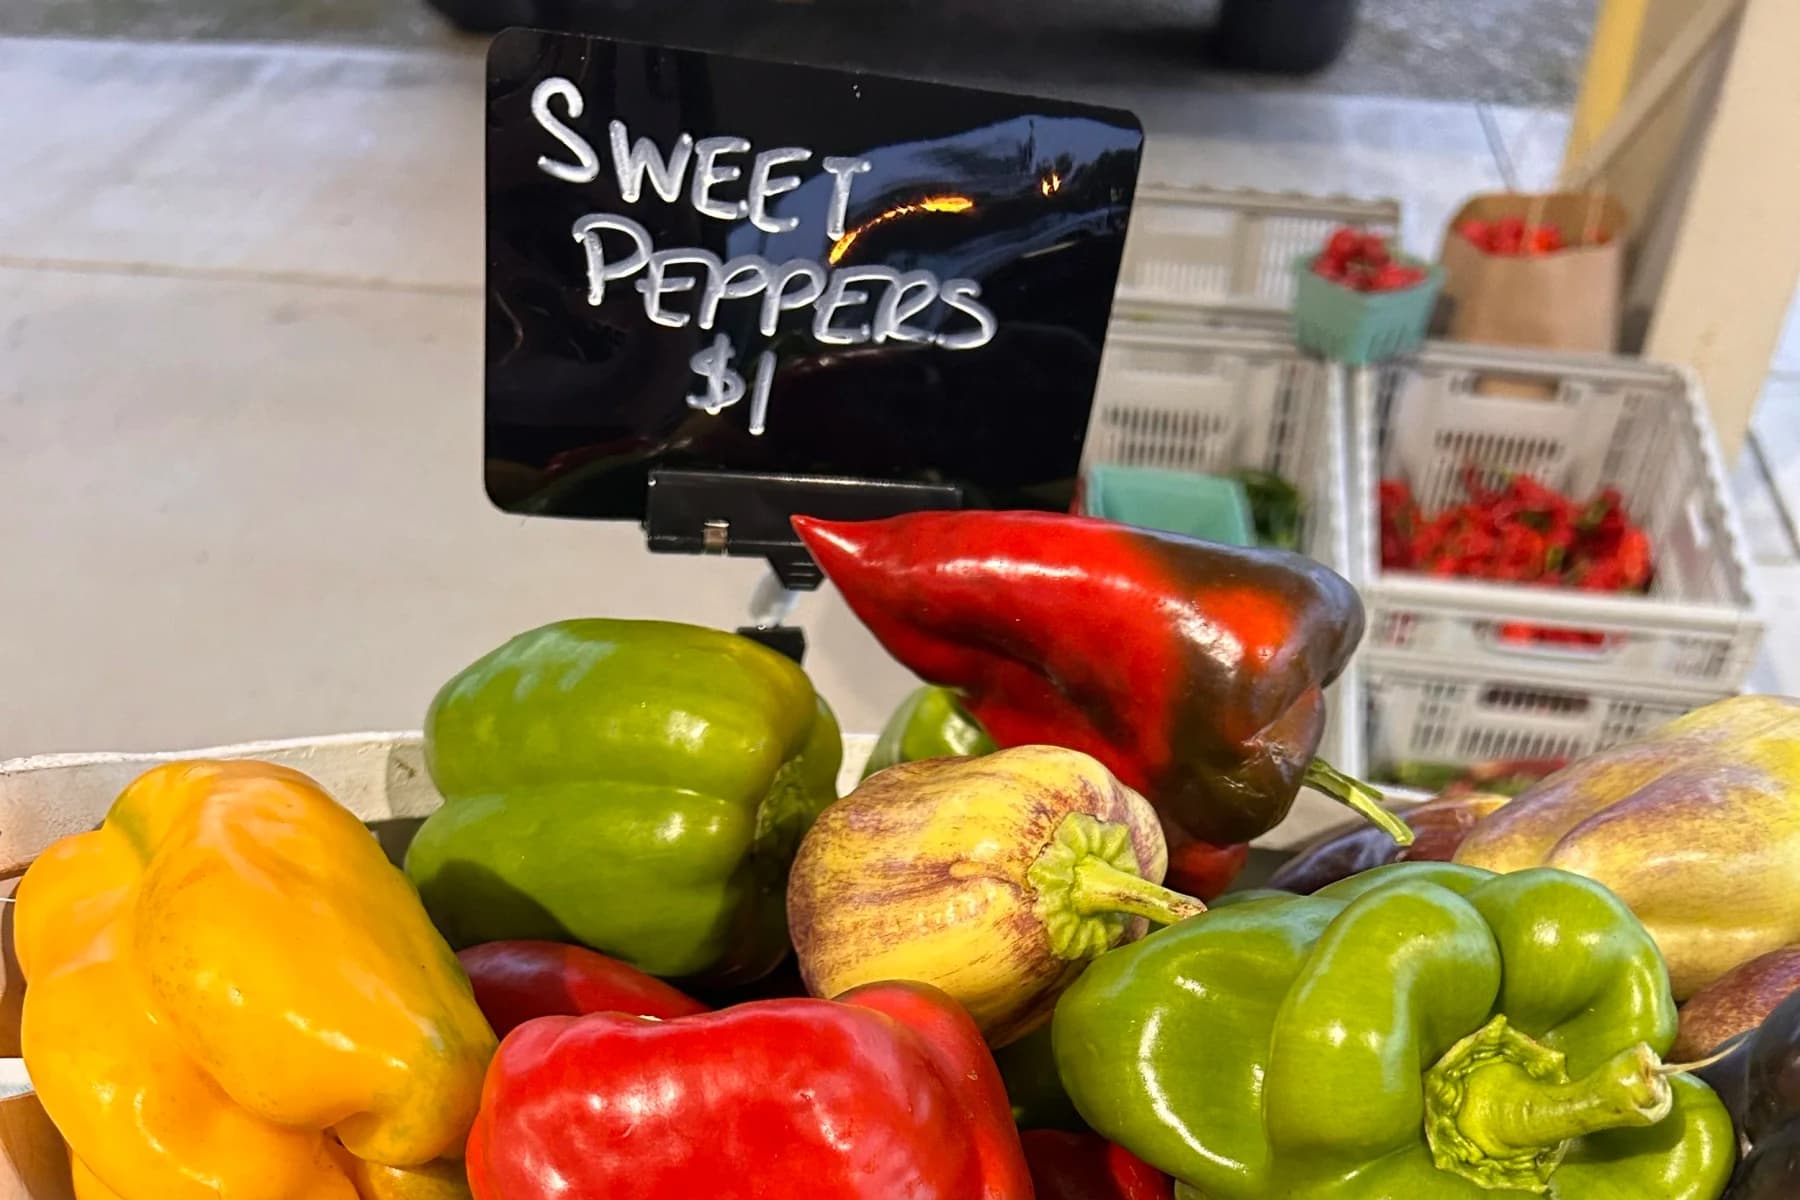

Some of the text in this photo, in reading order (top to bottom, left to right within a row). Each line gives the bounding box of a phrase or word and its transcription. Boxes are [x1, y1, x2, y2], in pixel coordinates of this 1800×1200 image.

[531, 77, 871, 239] SWEET
[573, 213, 997, 349] PEPPERS
[687, 333, 776, 435] $1
